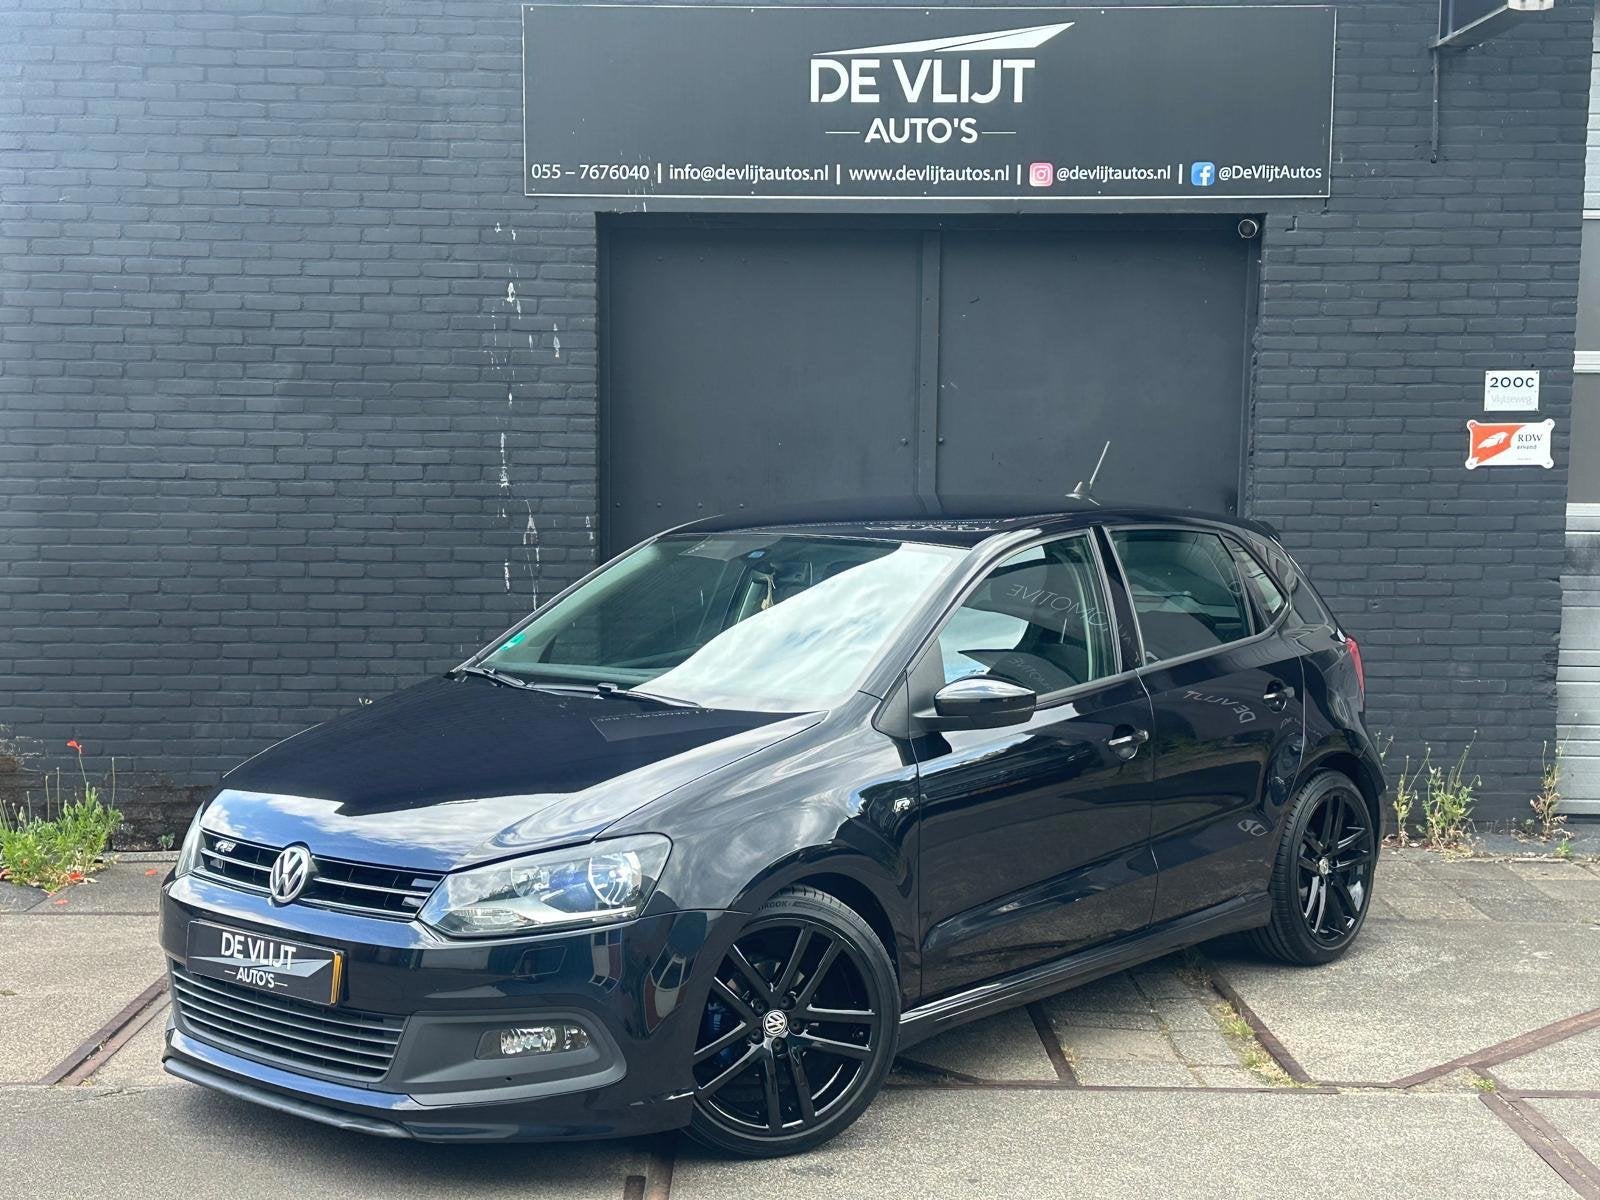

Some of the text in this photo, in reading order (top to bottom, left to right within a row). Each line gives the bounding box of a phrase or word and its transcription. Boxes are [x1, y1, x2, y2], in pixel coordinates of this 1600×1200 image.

[810, 59, 1036, 104] DE VLIJT
[864, 118, 979, 144] AUTO'S
[531, 164, 562, 179] 055
[579, 164, 650, 180] 7676040
[669, 163, 829, 184] info@devlijtautos.nl
[848, 164, 1010, 184] www.devlijtautos.nl
[1056, 164, 1171, 183] @devlijtautos.nl
[1218, 164, 1322, 183] @DeVlijtAutos
[1489, 376, 1535, 388] 200C
[1518, 433, 1543, 442] RDW
[221, 931, 297, 970] DE VLIJT
[236, 966, 275, 988] AUTO'S
